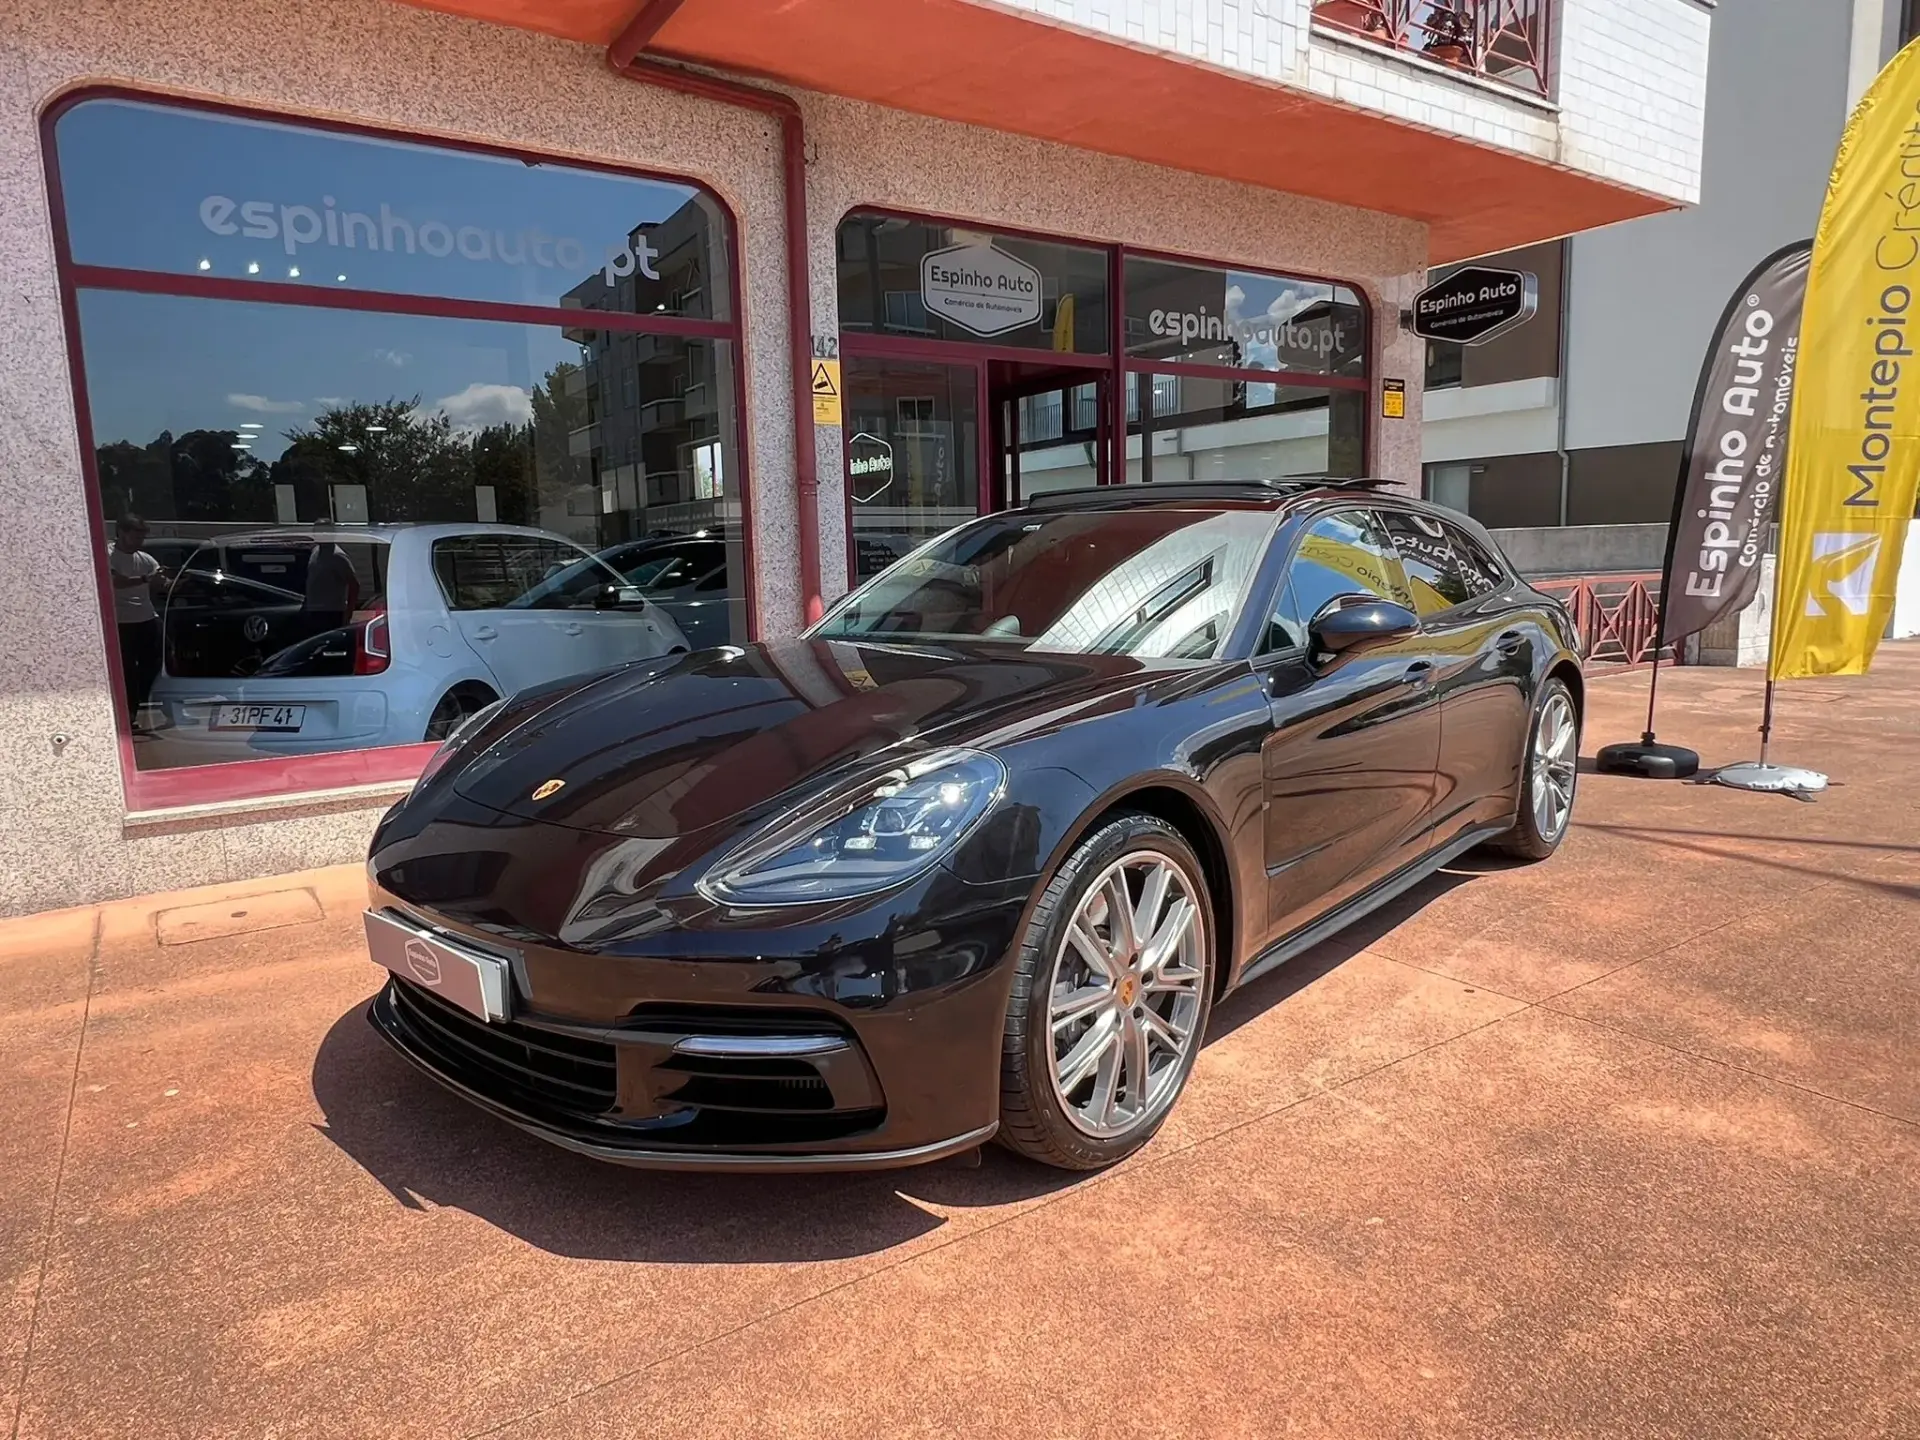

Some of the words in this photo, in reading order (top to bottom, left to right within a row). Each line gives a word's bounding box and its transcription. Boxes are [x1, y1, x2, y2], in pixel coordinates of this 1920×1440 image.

[1876, 99, 1920, 270] Crédit
[199, 194, 661, 288] espinhoautopt
[930, 265, 993, 289] Espinho
[998, 274, 1034, 293] Auto
[1420, 291, 1475, 314] Espinho
[1480, 282, 1517, 301] Auto
[811, 335, 838, 360] 142
[1148, 305, 1345, 359] espinhoauto.pt
[1843, 284, 1914, 507] Montepio
[850, 458, 868, 475] inho
[1755, 454, 1772, 477] de
[1685, 430, 1748, 598] Espinho
